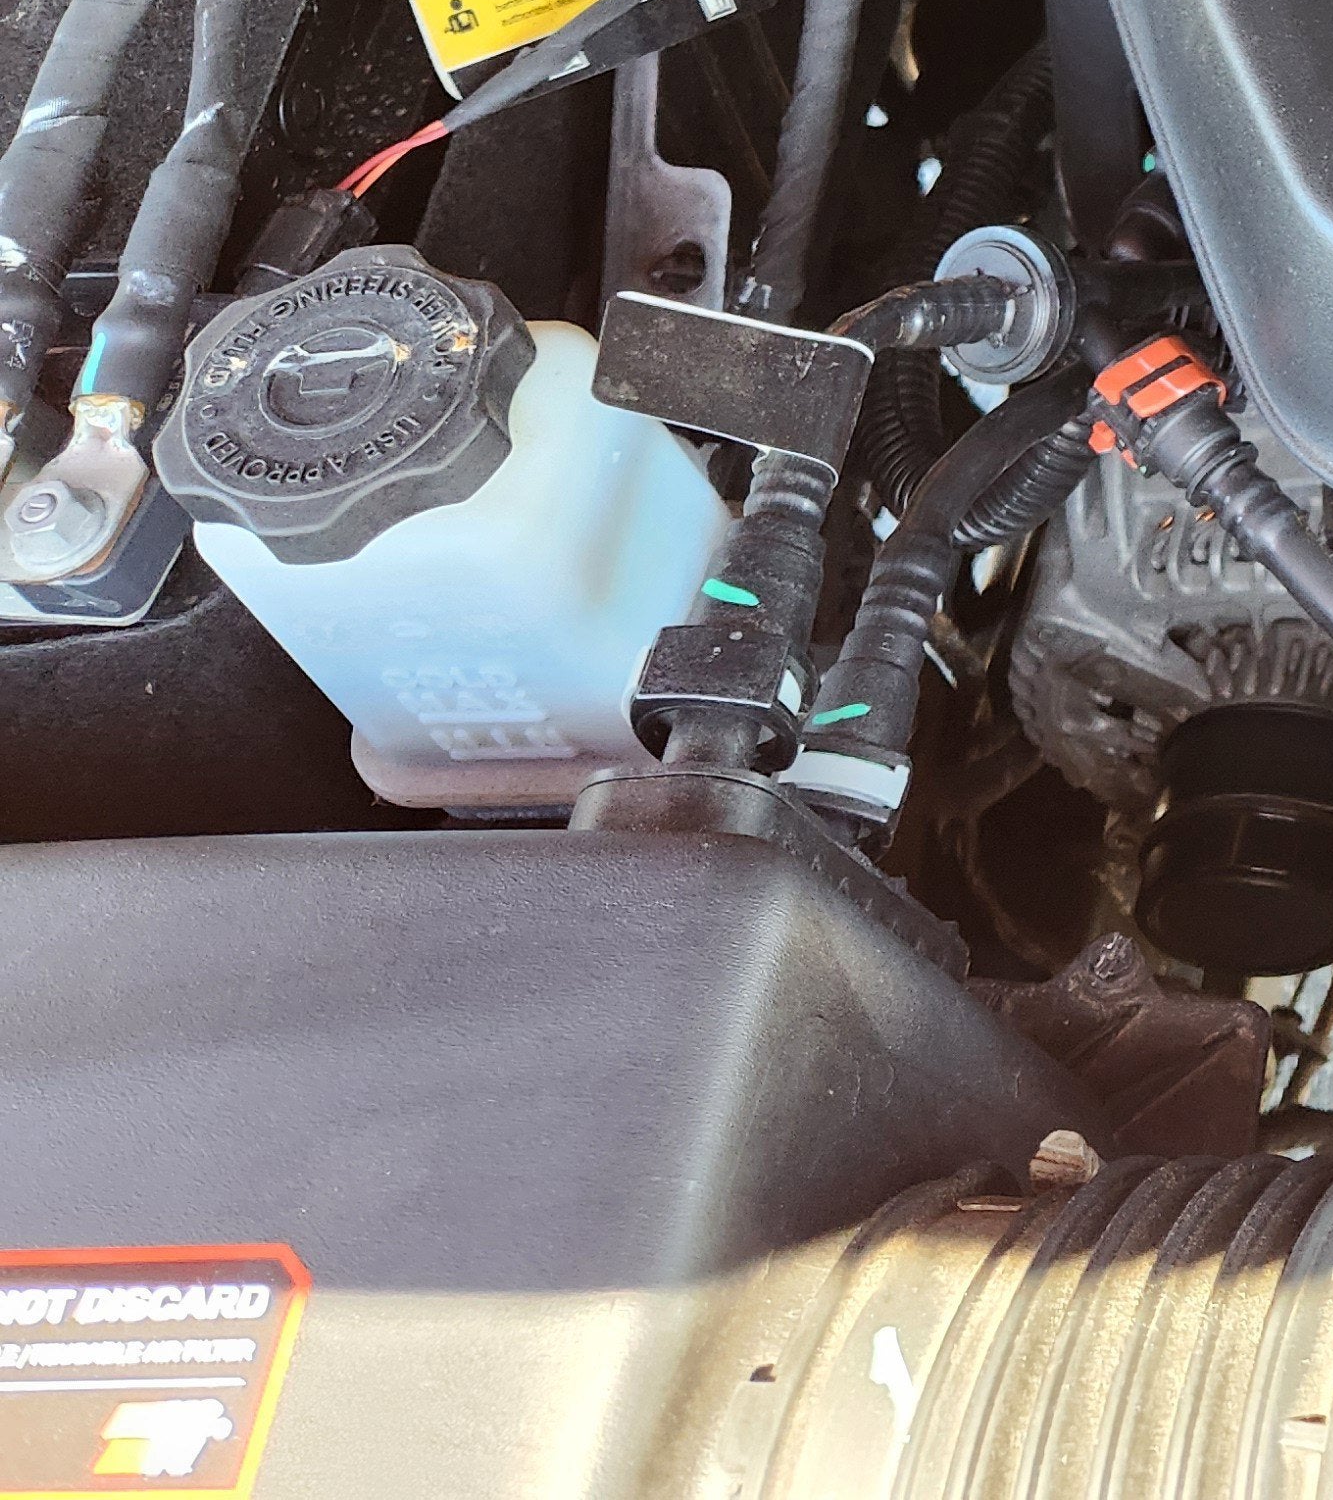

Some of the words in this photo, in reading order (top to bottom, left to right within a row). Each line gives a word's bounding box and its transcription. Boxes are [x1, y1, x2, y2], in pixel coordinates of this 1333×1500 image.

[268, 273, 415, 320] STEERING
[202, 320, 268, 388] FLUID
[411, 286, 468, 375] POWER
[203, 431, 355, 485] APPROVED
[361, 414, 421, 460] USE
[73, 1285, 271, 1324] DISCARD
